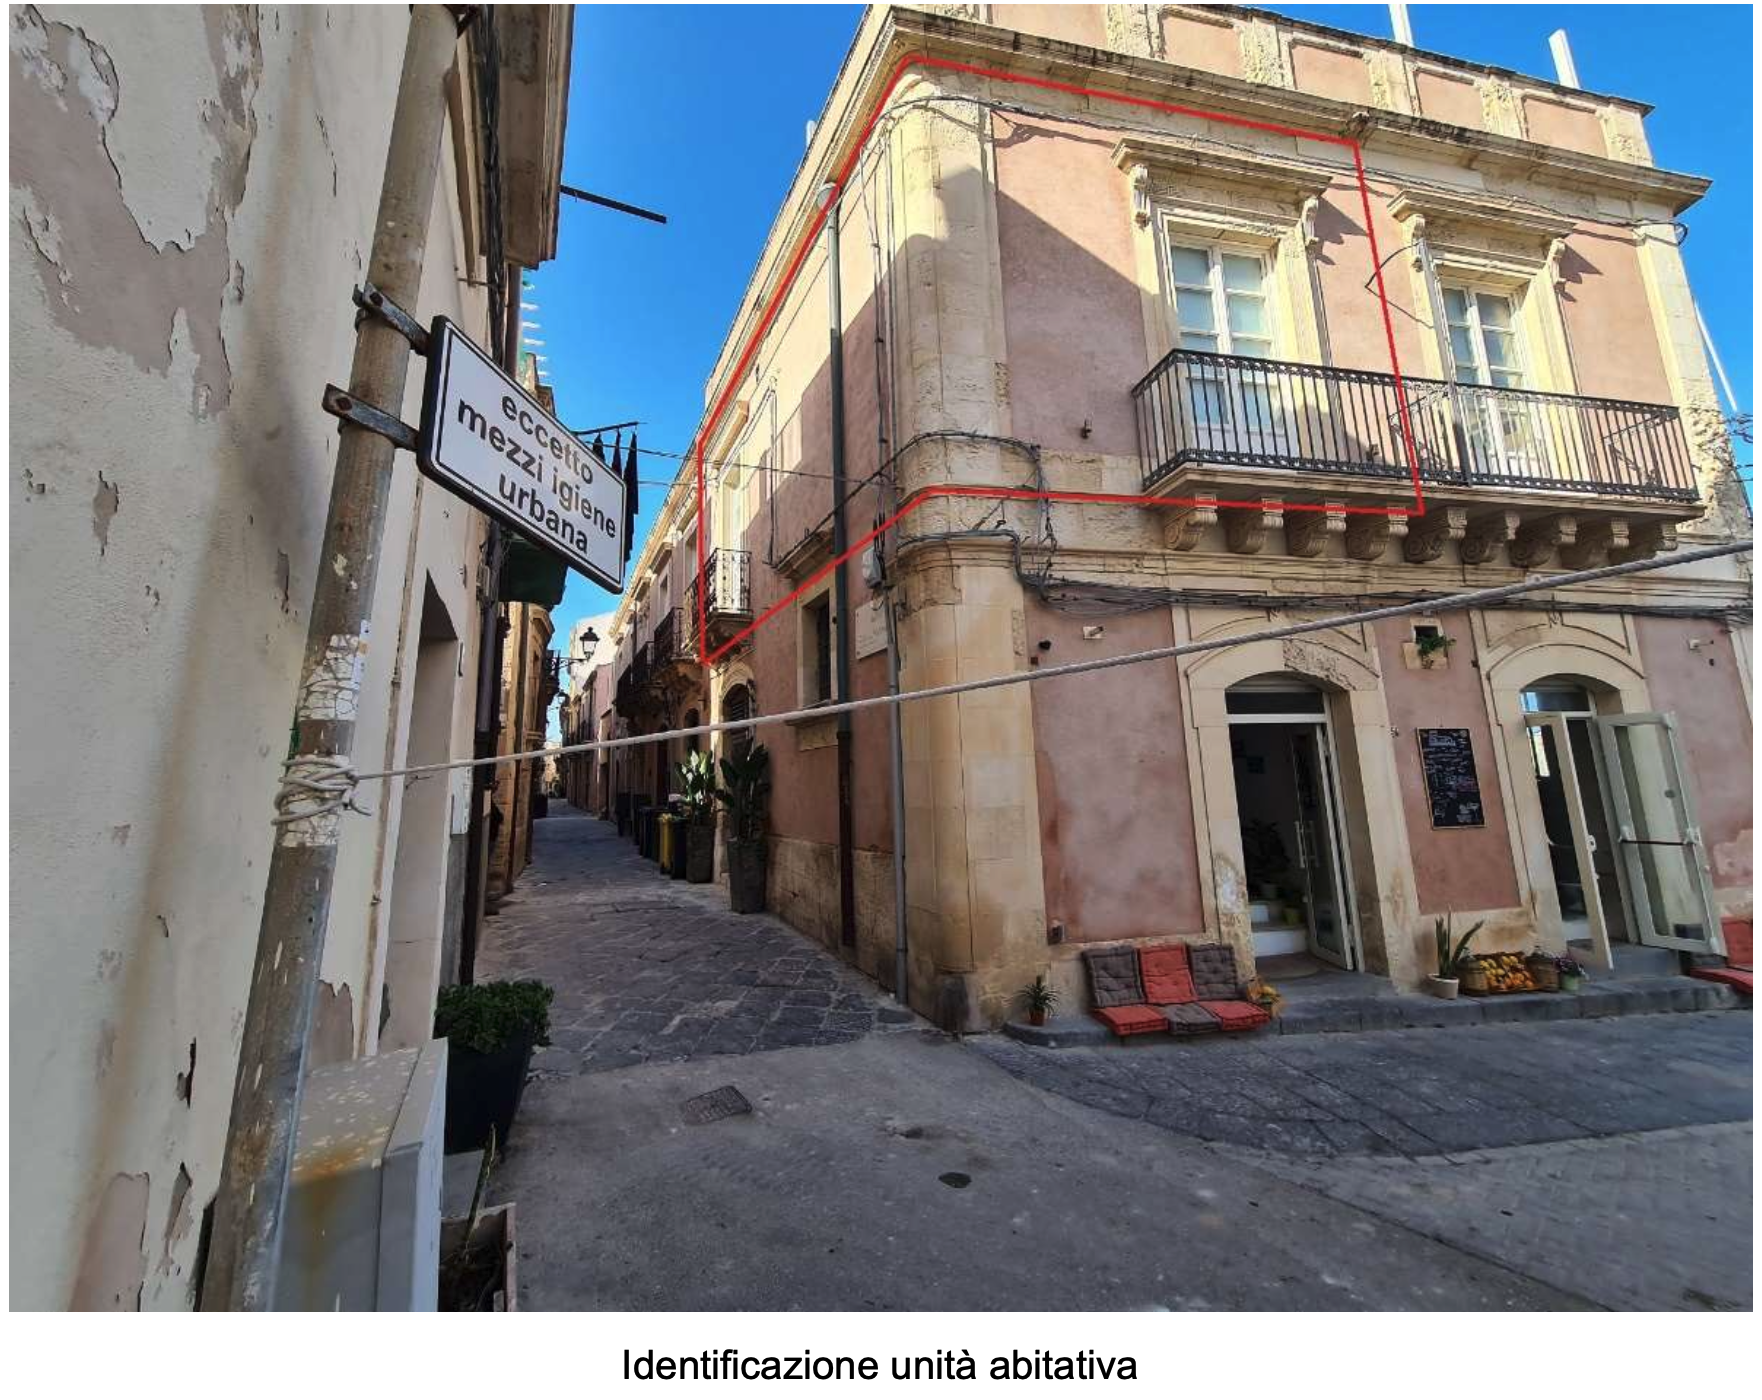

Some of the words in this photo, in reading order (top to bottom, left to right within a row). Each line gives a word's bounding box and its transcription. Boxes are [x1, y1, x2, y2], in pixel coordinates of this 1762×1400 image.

[457, 398, 543, 482] mezzi
[552, 467, 616, 538] igiene
[502, 395, 594, 484] eccetto
[499, 473, 588, 554] urbana
